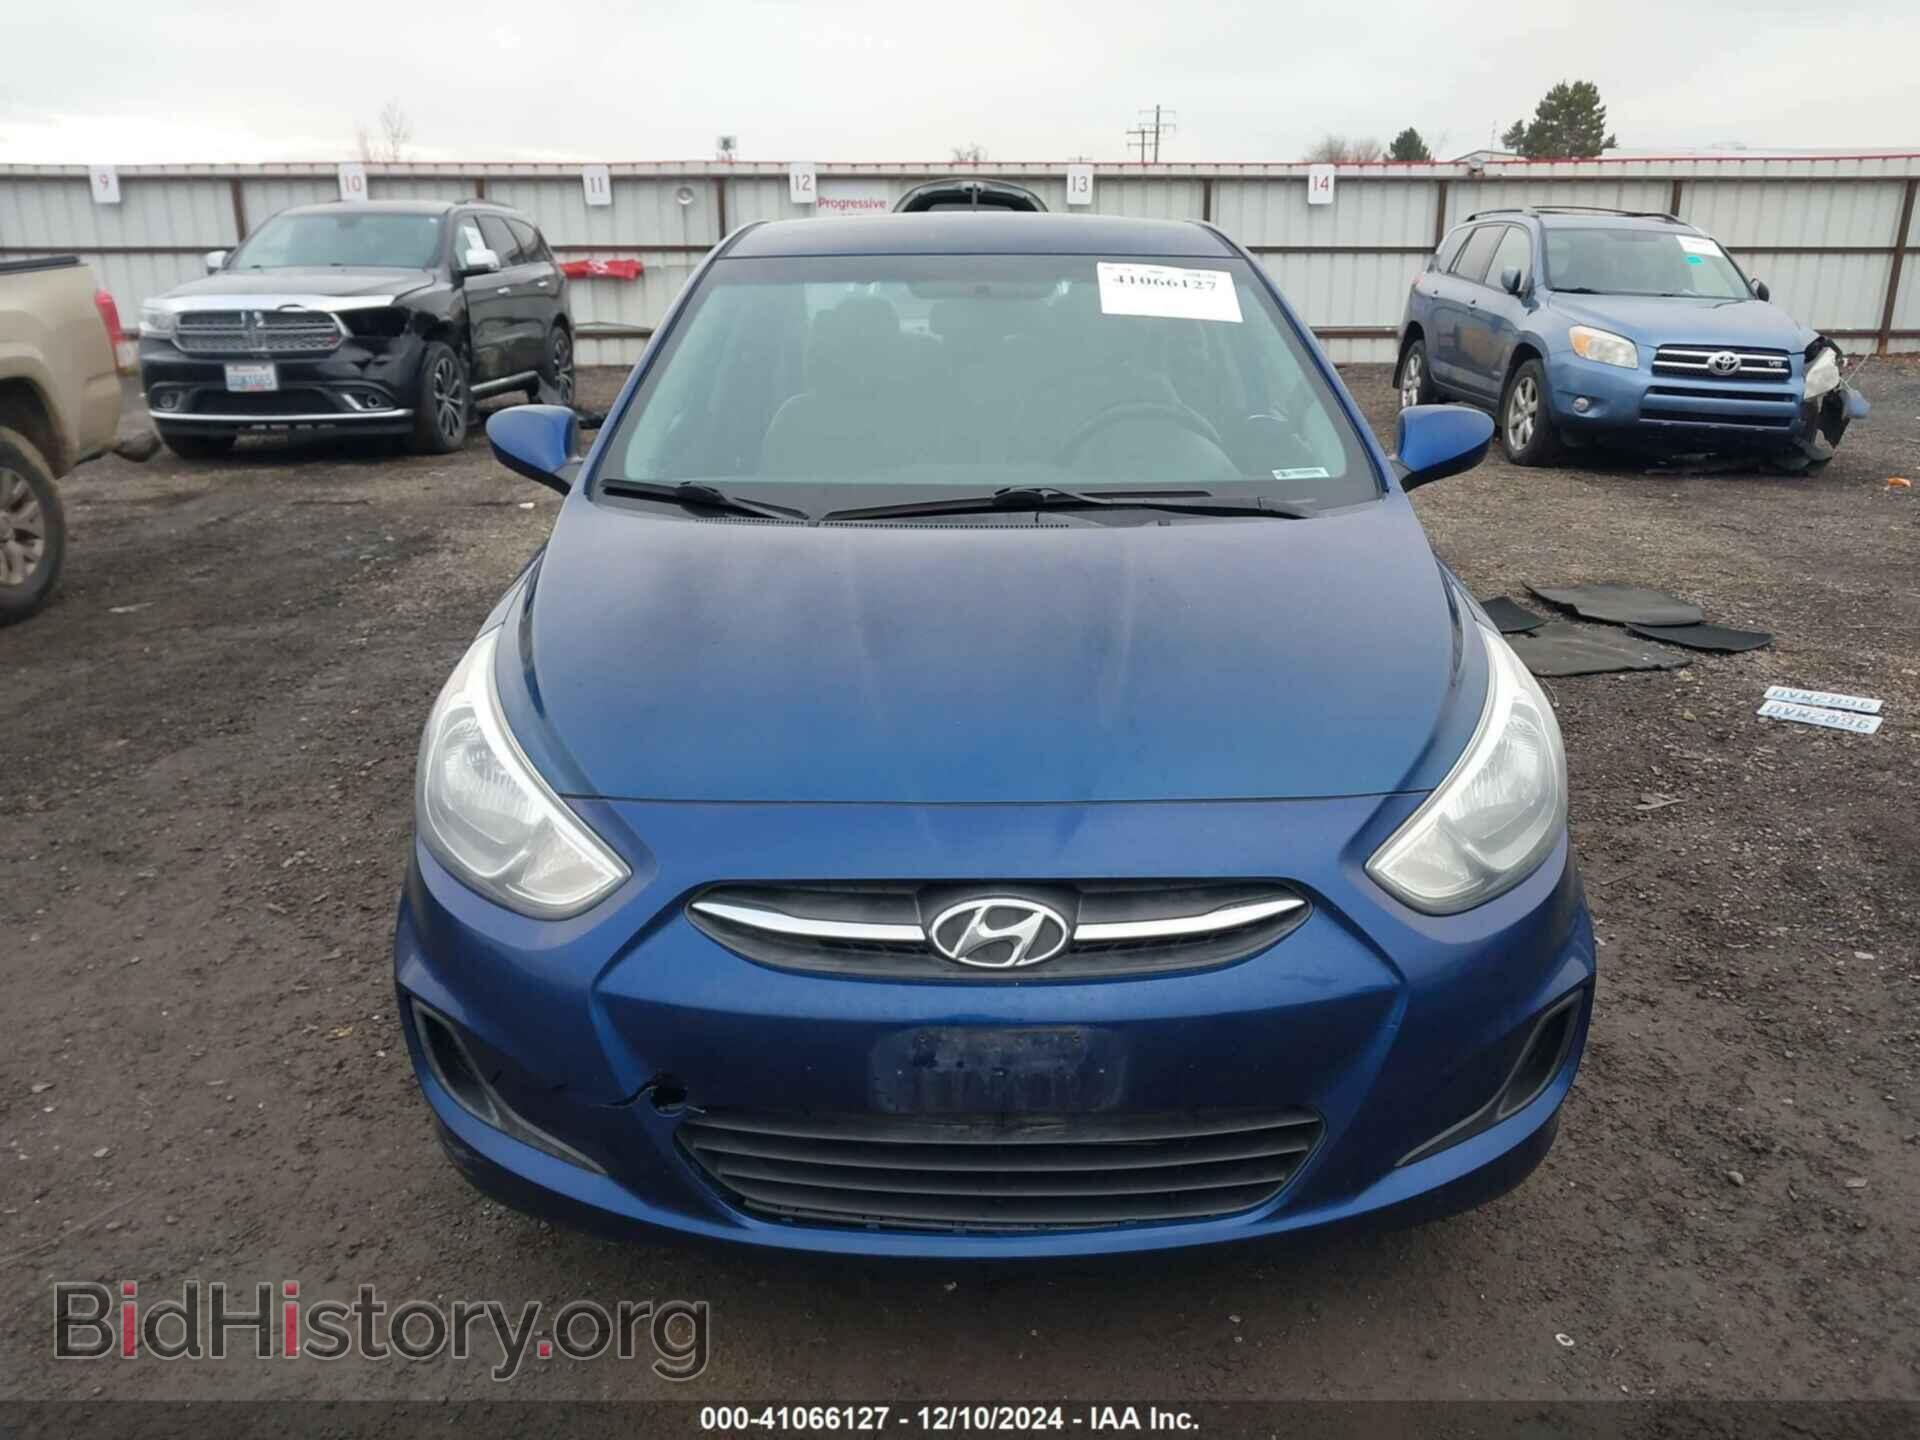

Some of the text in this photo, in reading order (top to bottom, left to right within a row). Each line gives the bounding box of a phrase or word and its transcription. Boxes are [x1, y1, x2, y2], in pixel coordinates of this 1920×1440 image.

[98, 174, 109, 192] 9
[345, 175, 361, 193] 10
[590, 175, 603, 193] 11
[795, 174, 811, 192] 12
[1072, 175, 1088, 193] 13
[1314, 175, 1329, 192] 14
[817, 197, 886, 211] Progressive
[1112, 274, 1217, 291] 41066127
